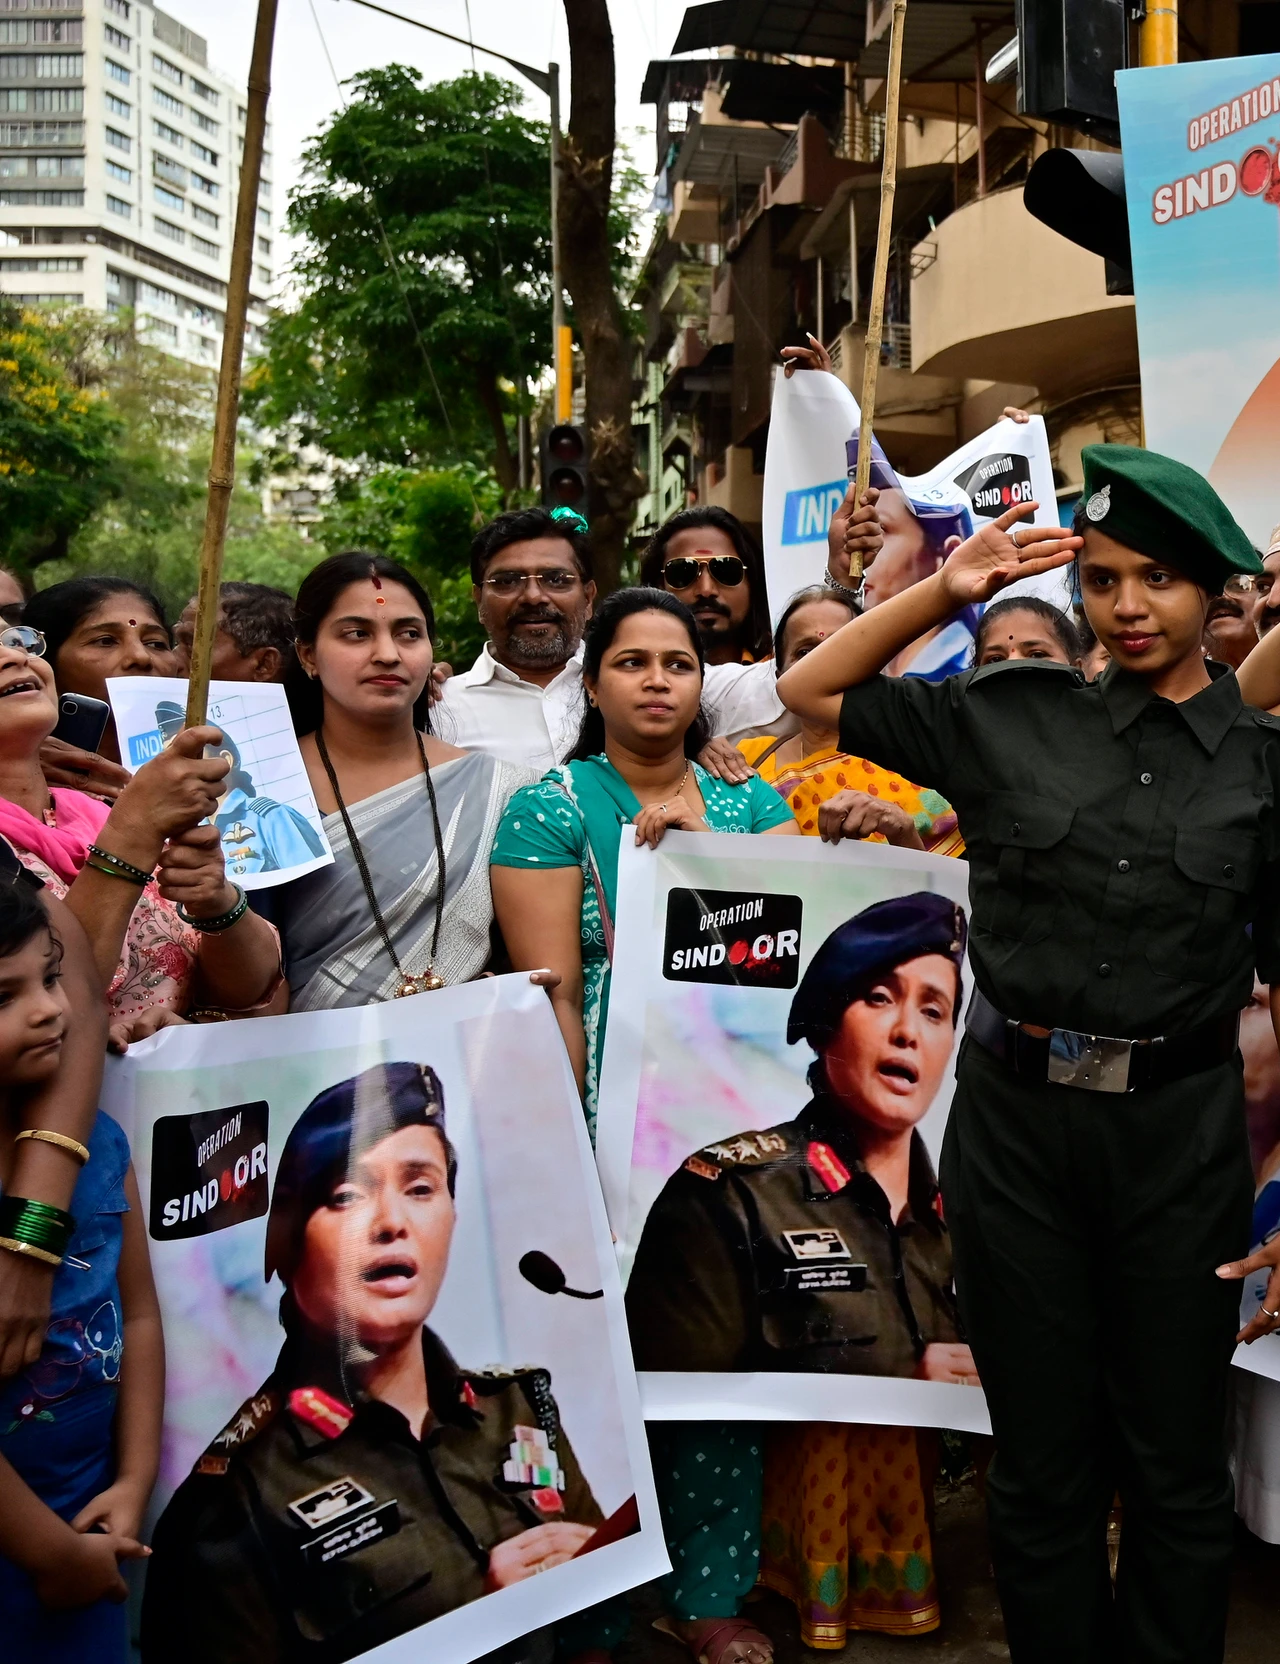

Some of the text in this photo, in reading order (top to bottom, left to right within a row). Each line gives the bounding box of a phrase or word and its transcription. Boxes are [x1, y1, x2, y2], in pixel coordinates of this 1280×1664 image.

[979, 456, 1014, 480] OPERATION
[699, 898, 764, 932] OPERATION
[197, 1111, 242, 1168] OPERATION
